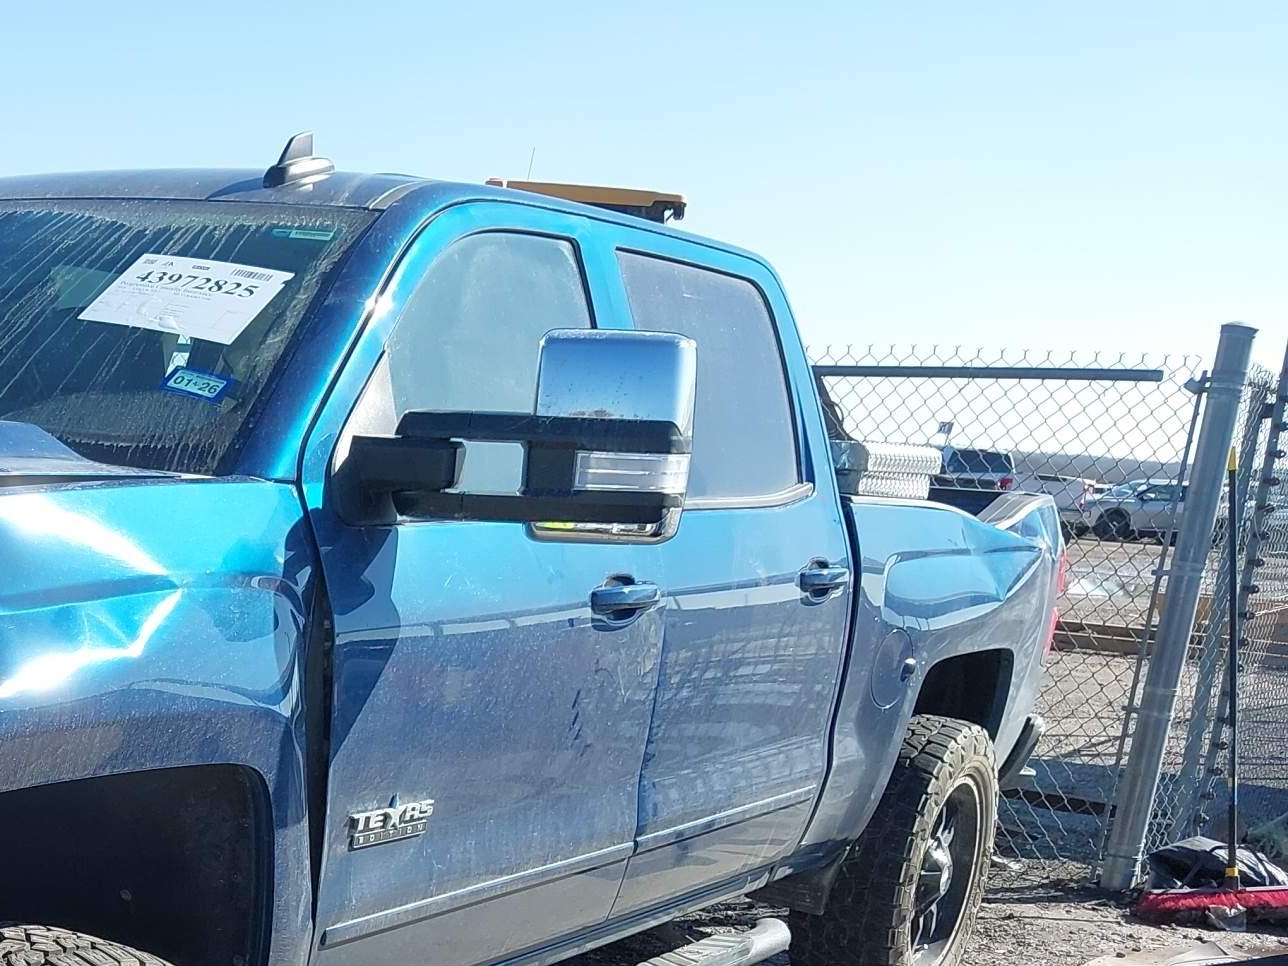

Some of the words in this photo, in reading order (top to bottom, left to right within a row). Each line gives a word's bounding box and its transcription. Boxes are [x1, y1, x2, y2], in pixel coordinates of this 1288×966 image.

[135, 268, 260, 299] 43972825
[198, 381, 220, 394] 26
[348, 798, 435, 833] TEXAS
[357, 822, 424, 844] EDITION
